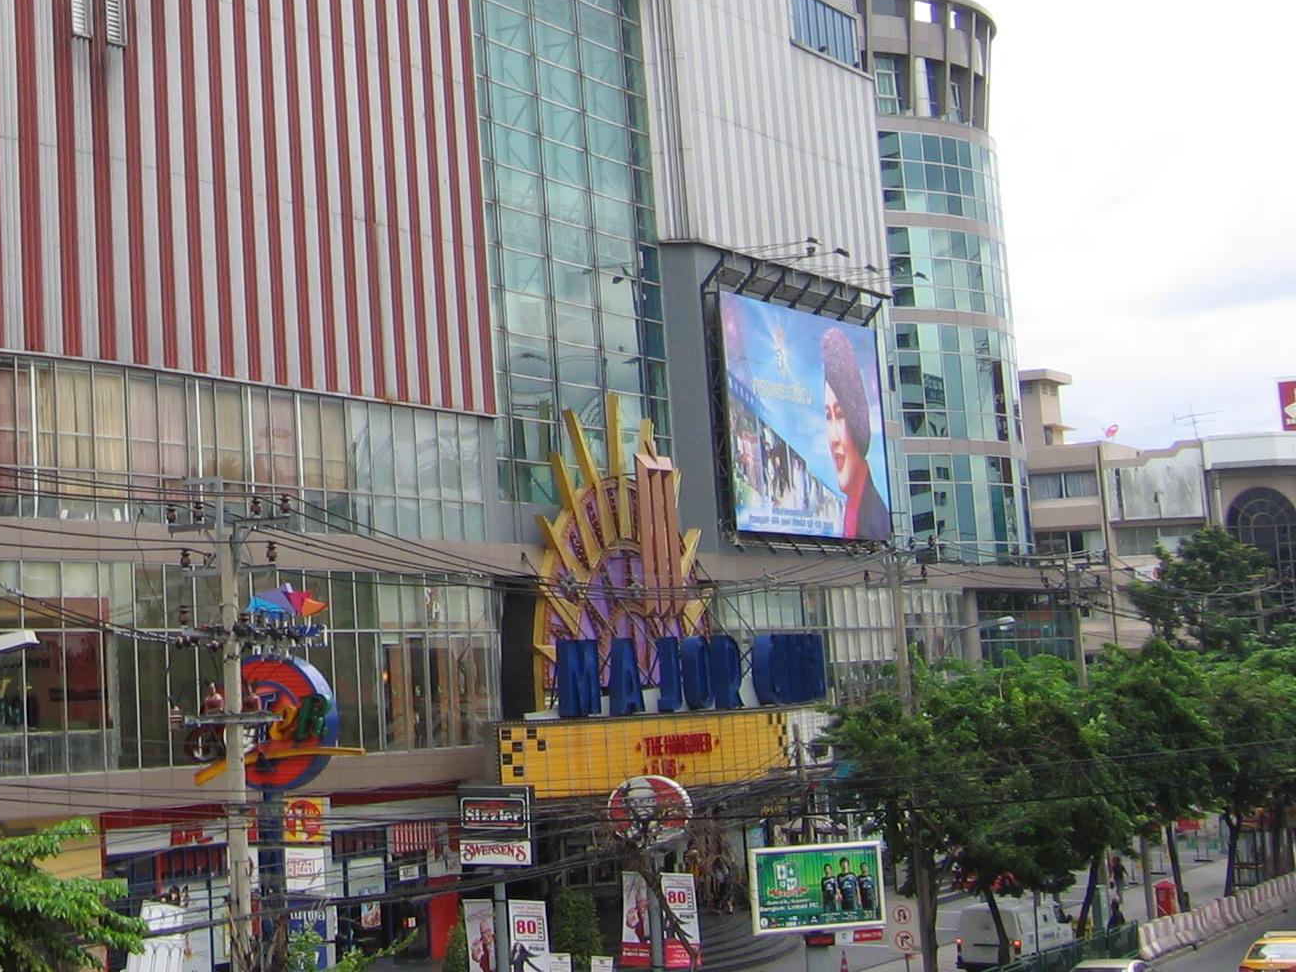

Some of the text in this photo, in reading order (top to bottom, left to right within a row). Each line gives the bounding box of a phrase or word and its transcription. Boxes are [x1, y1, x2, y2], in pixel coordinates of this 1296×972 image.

[555, 634, 745, 718] MAJOR
[465, 808, 522, 821] Sizzler
[668, 890, 686, 904] 80
[516, 919, 537, 934] 80
